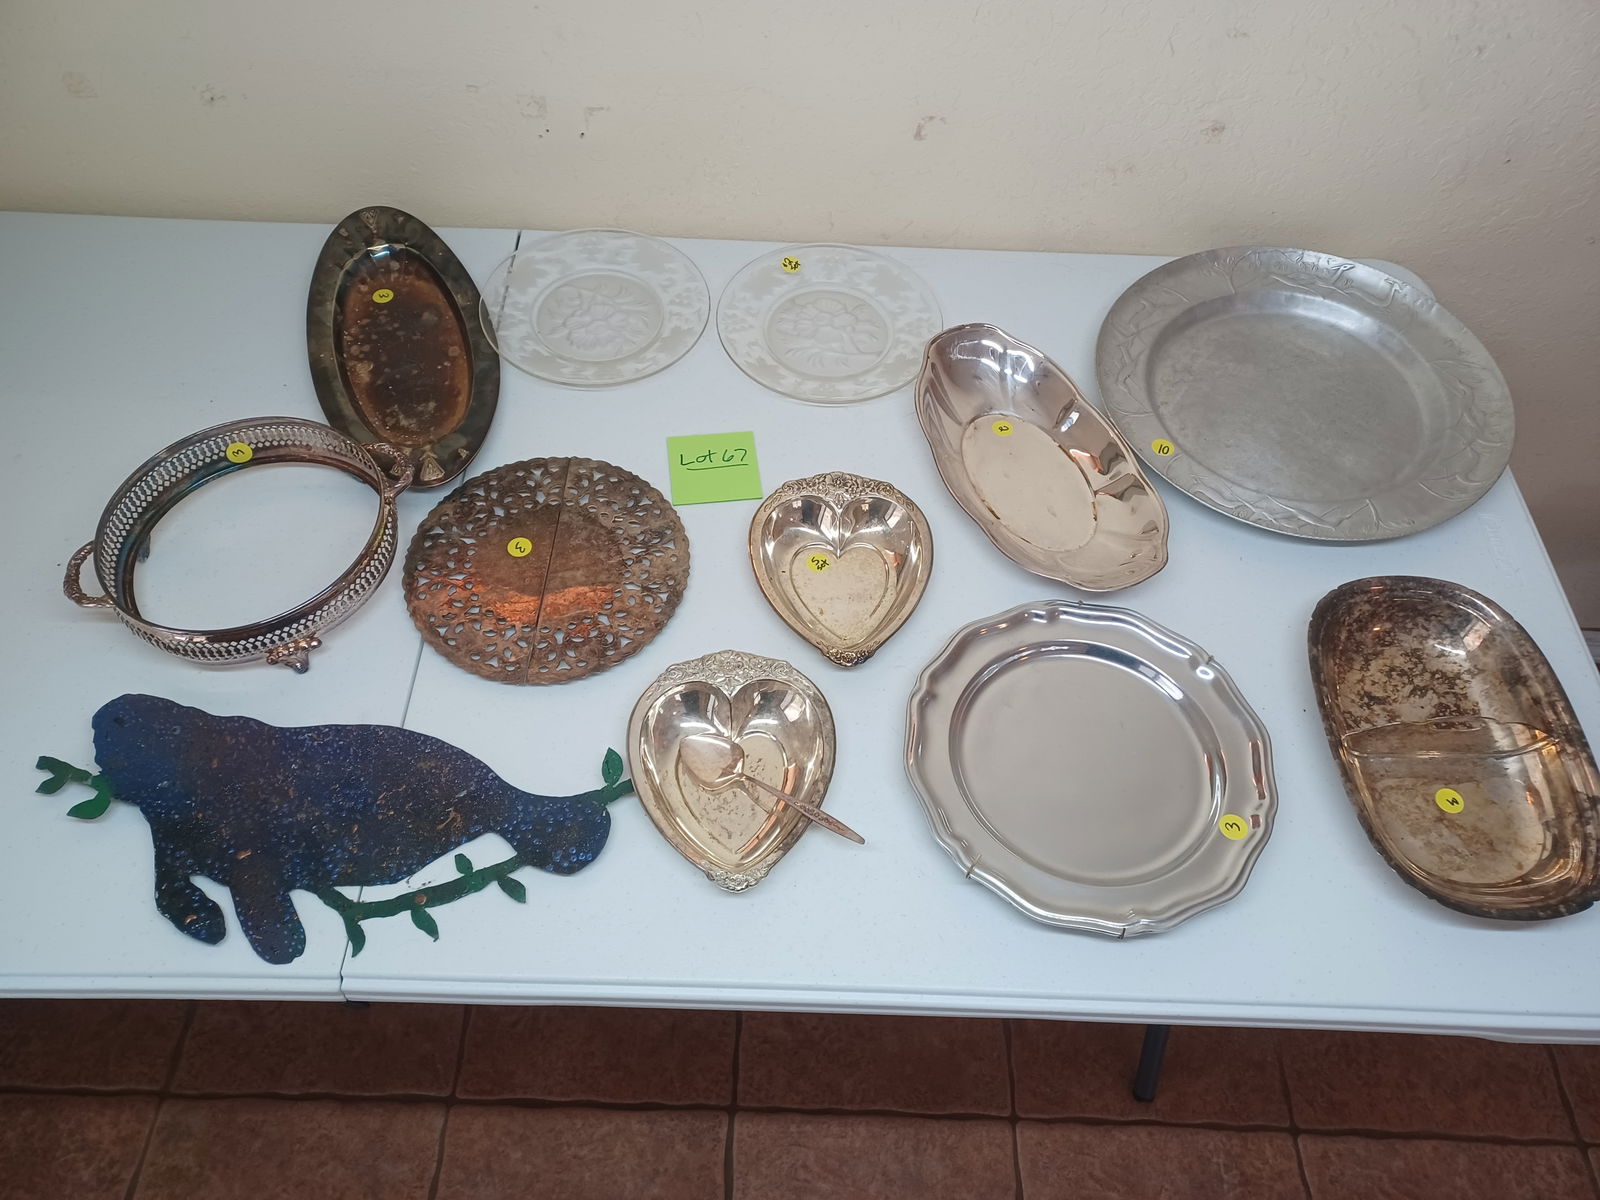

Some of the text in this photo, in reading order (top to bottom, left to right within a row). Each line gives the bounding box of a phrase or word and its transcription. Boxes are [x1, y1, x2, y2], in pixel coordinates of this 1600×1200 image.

[1157, 444, 1170, 455] 10
[680, 448, 748, 466] Lot 67
